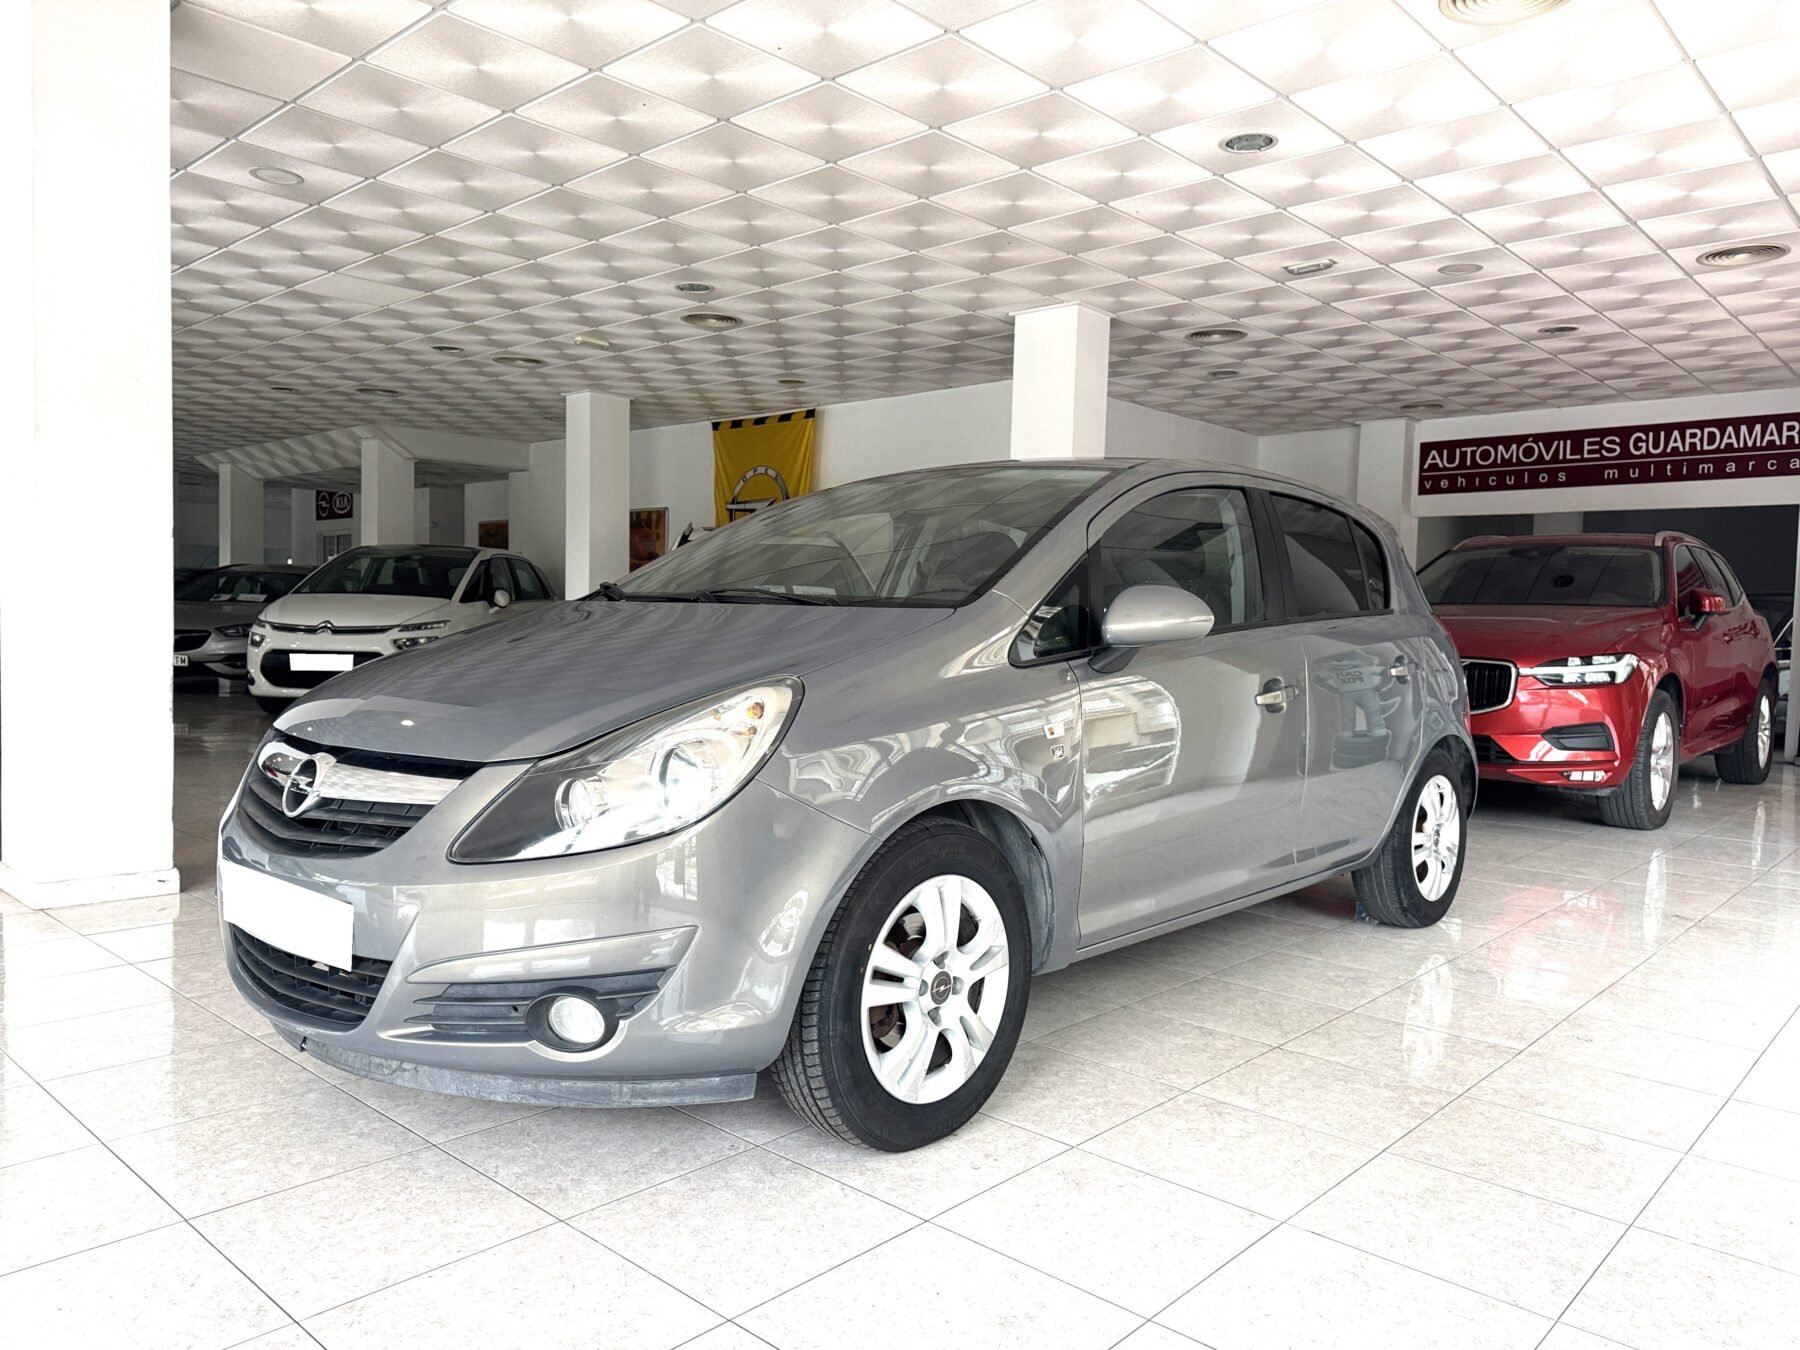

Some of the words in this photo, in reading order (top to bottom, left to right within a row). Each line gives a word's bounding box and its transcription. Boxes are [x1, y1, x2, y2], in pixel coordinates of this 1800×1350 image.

[1423, 436, 1621, 470] AUTOMÓVILES
[1629, 420, 1800, 456] GUARDAMAR
[742, 467, 778, 482] OPEL
[1604, 458, 1800, 479] multimarca
[335, 495, 349, 509] KIA
